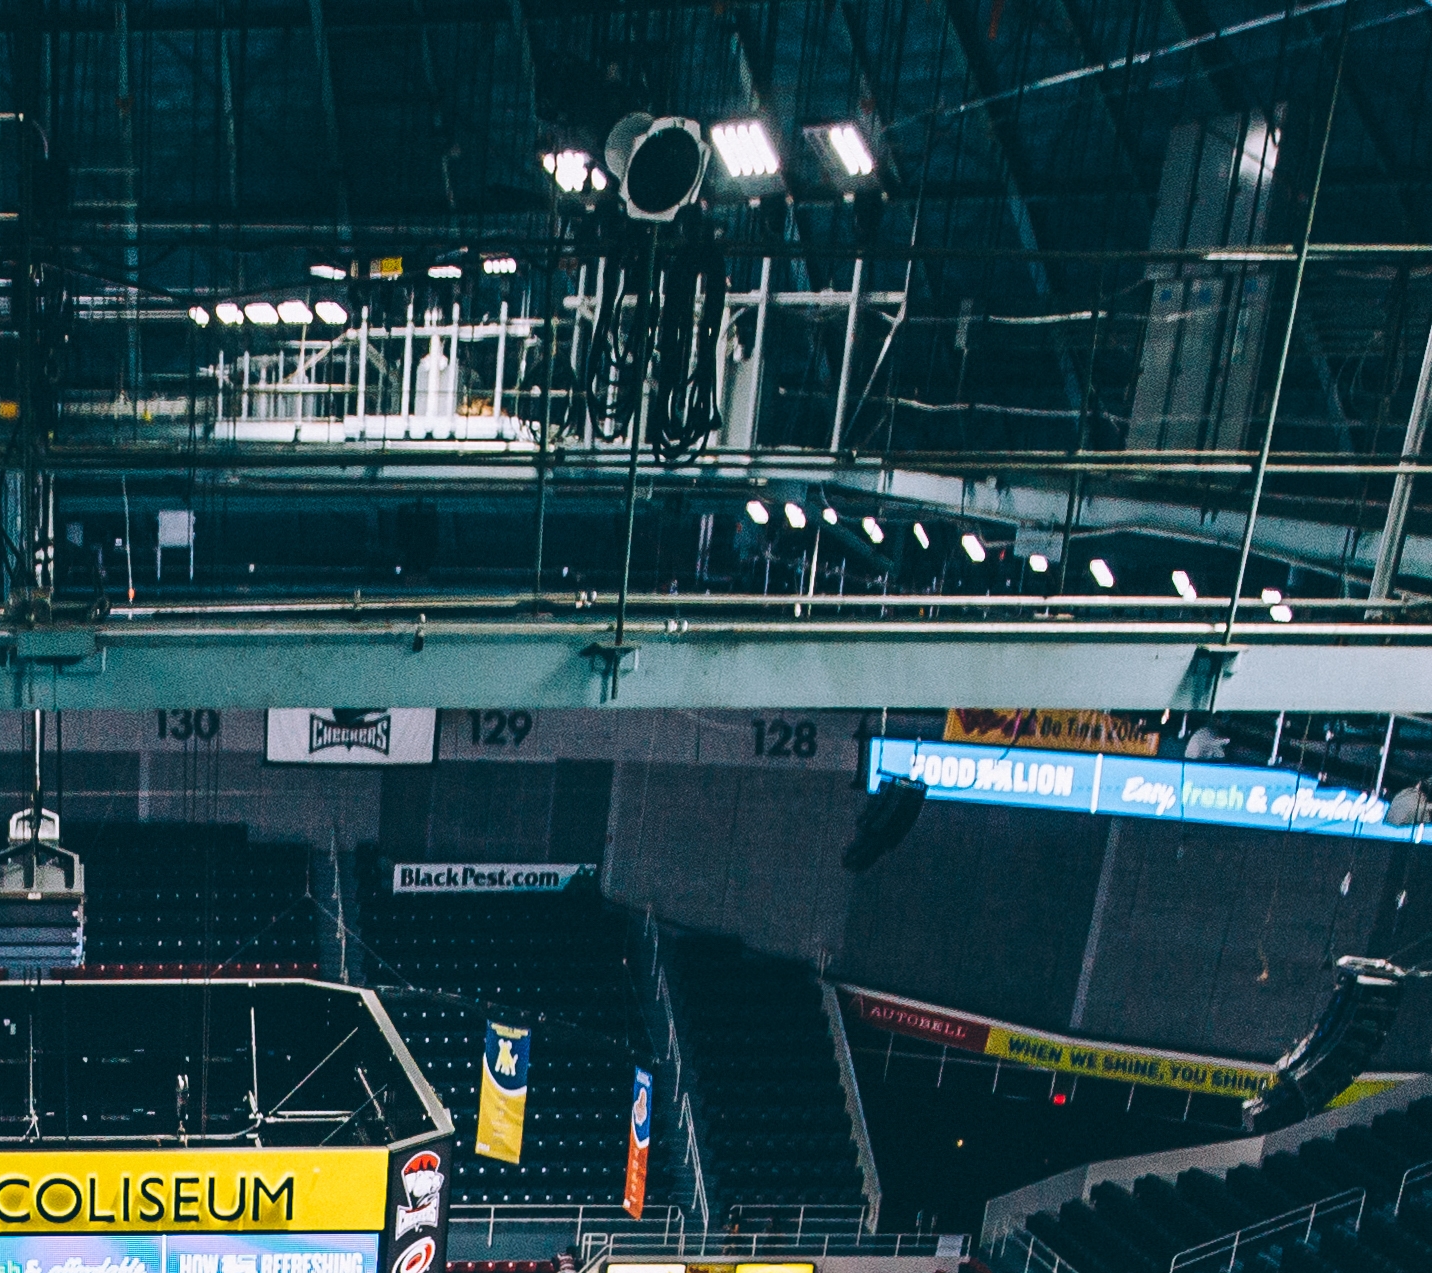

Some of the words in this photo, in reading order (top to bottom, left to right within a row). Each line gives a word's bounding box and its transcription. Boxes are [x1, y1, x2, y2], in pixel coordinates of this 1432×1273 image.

[155, 708, 221, 740] 130
[468, 708, 533, 746] 129
[750, 718, 818, 759] 128
[1011, 763, 1075, 797] LION
[1181, 779, 1245, 811] fresh
[1245, 785, 1269, 814] &
[399, 866, 560, 889] BlackPest.com
[869, 1005, 967, 1039] AUTOBELL
[1007, 1035, 1064, 1064] WHEN
[1068, 1048, 1099, 1070] WE
[1170, 1062, 1206, 1086] YOU
